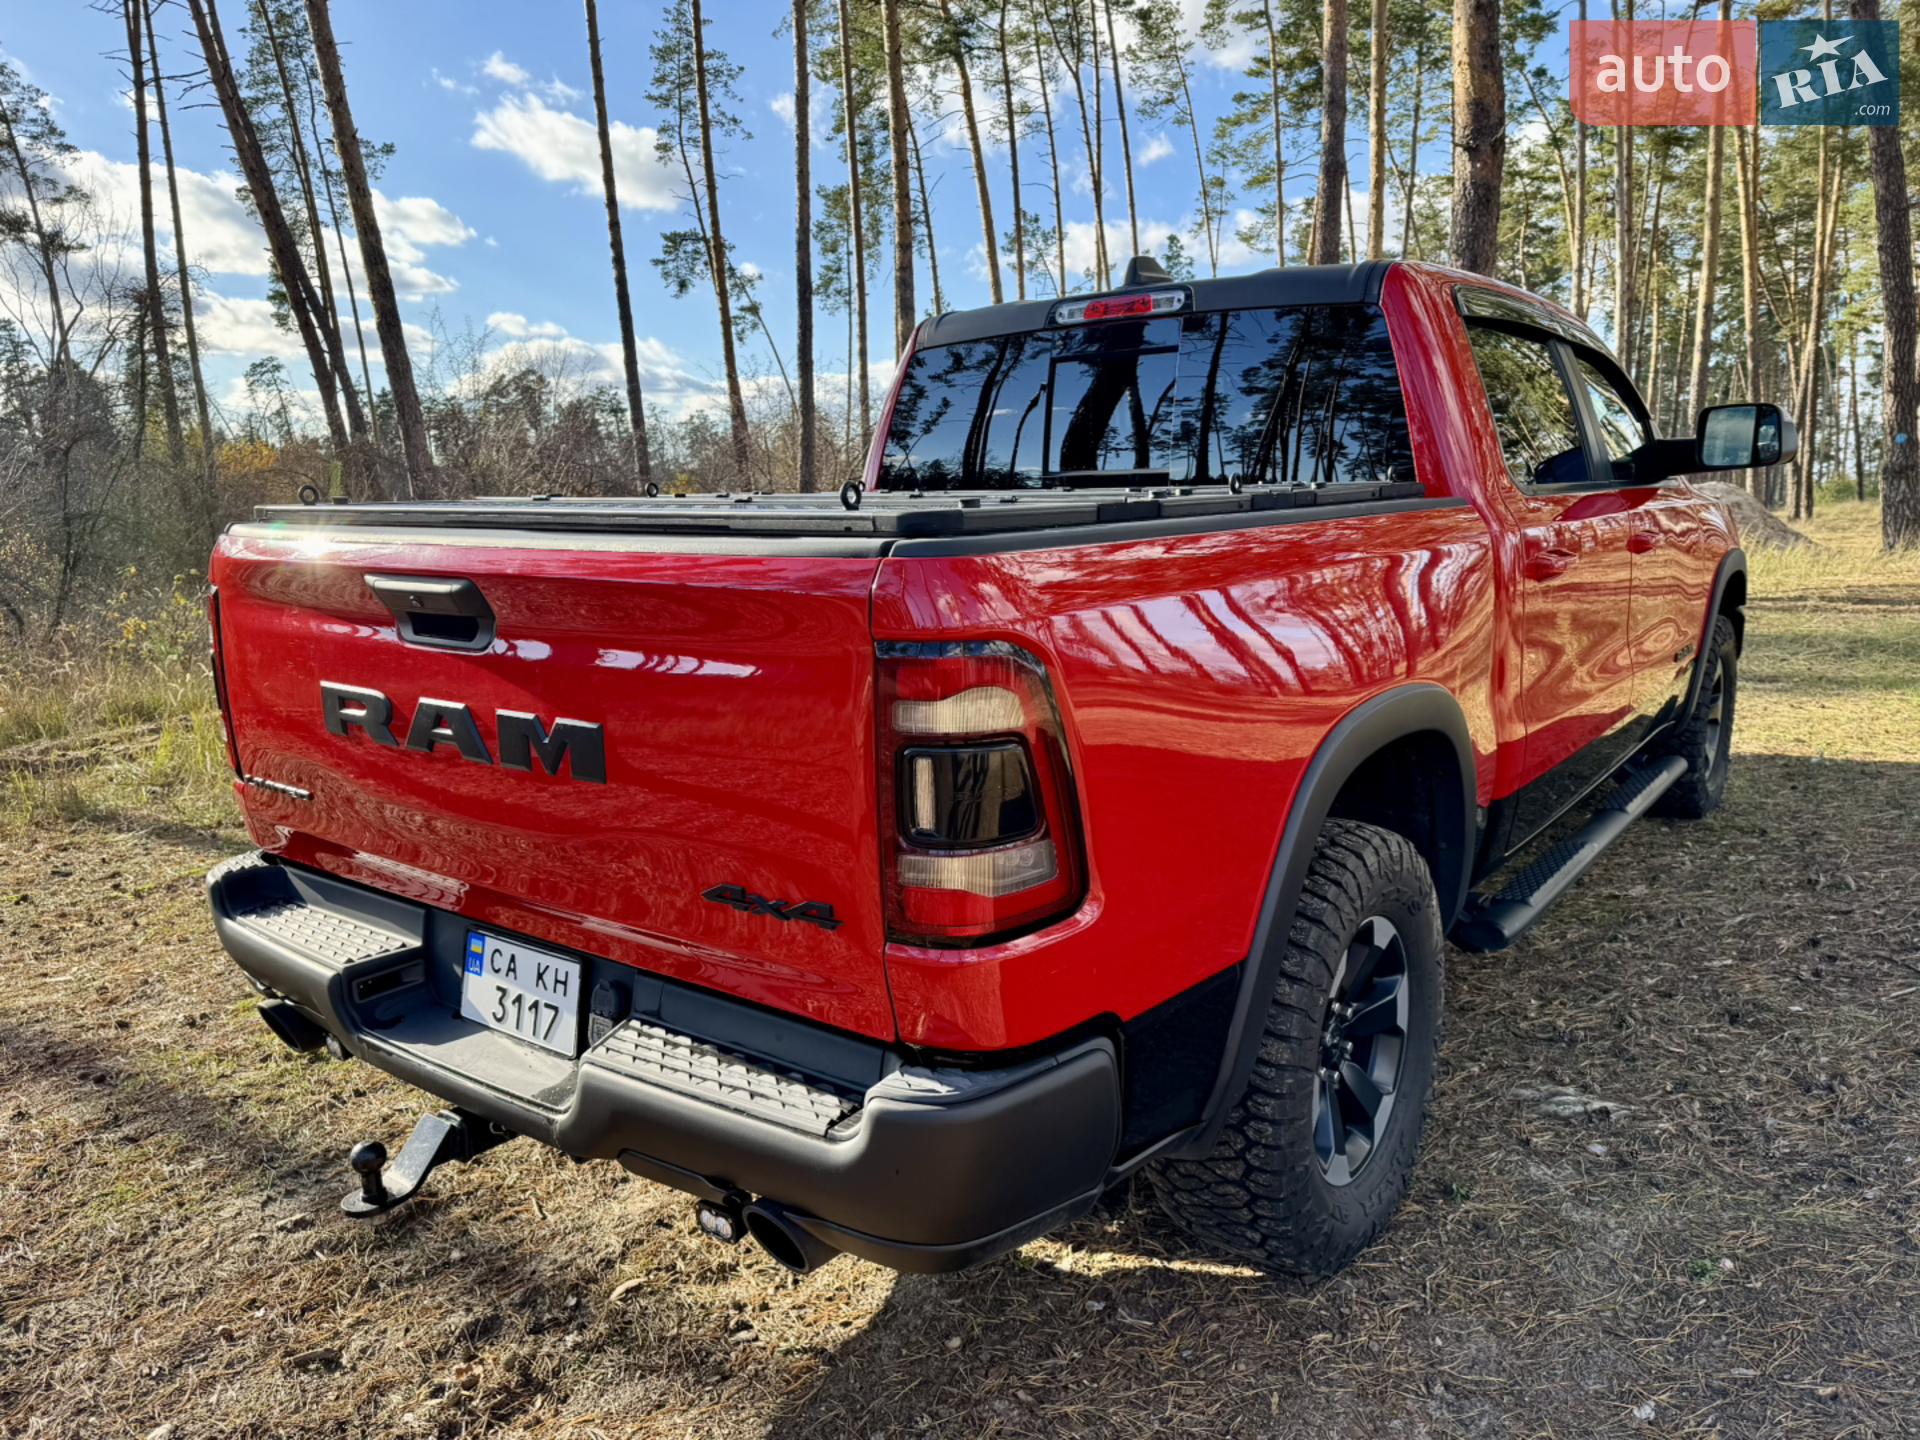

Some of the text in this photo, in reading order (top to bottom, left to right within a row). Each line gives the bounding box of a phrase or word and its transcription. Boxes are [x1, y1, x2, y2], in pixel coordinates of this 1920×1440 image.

[319, 680, 607, 784] RAM
[468, 957, 481, 975] UA
[490, 948, 569, 998] CA KH
[492, 985, 560, 1041] 3117
